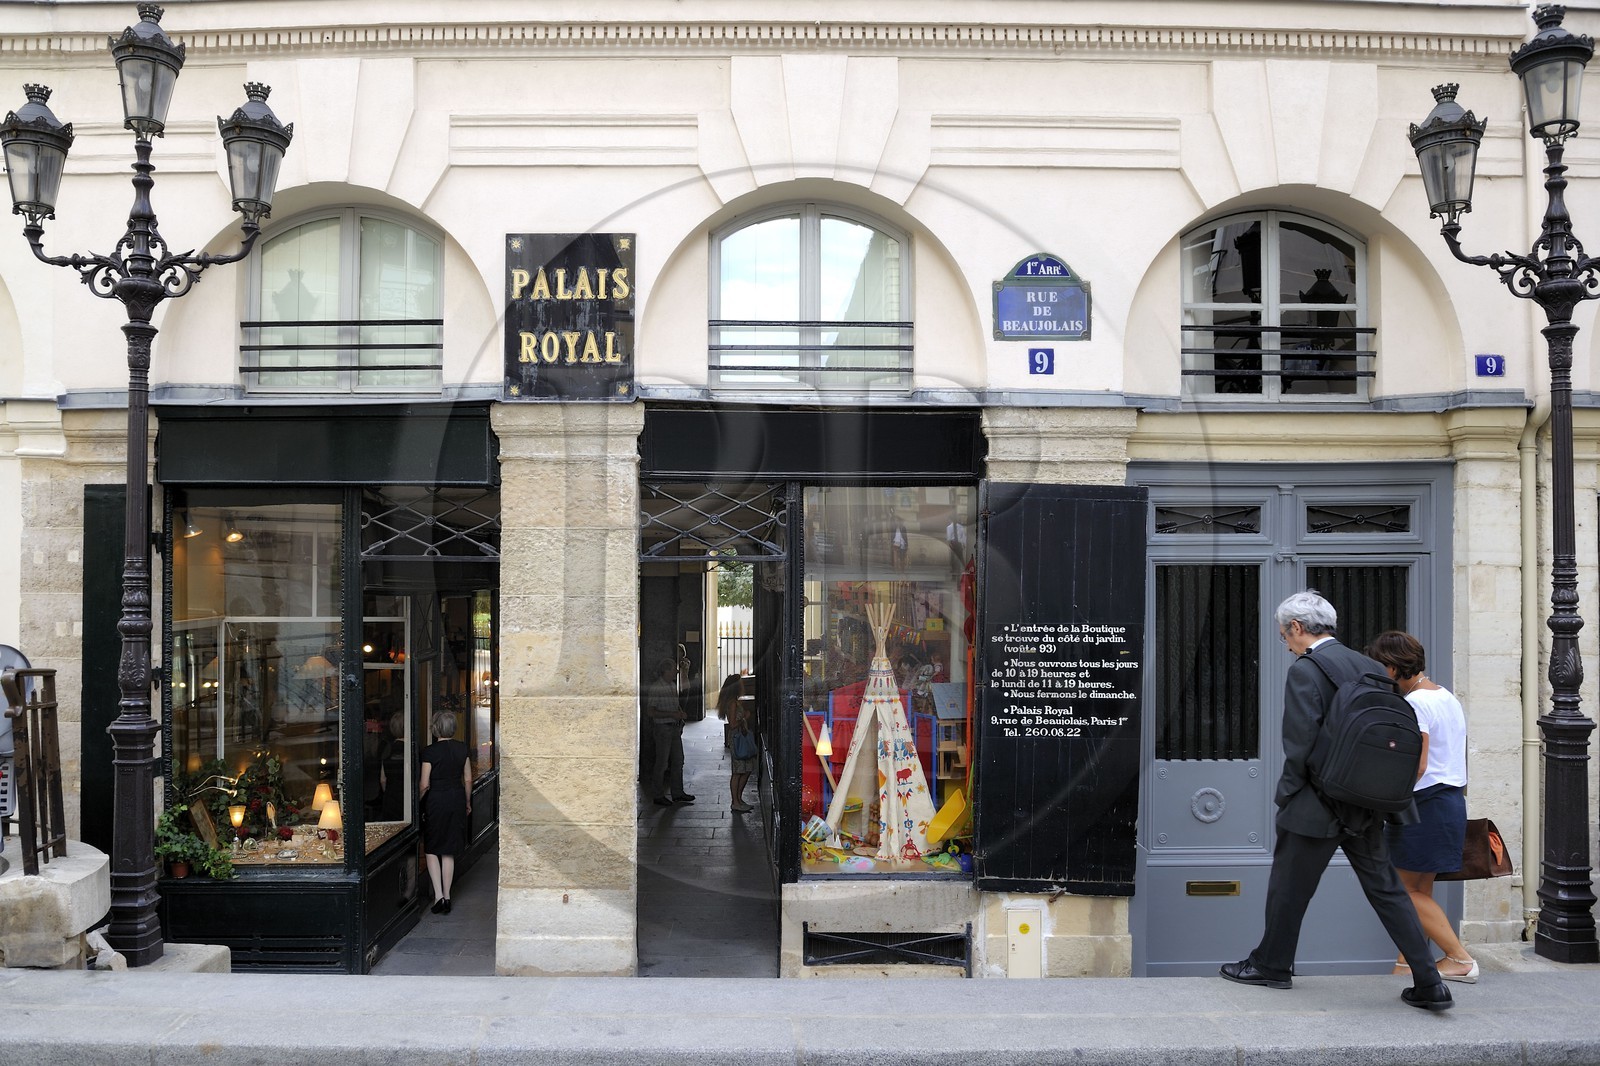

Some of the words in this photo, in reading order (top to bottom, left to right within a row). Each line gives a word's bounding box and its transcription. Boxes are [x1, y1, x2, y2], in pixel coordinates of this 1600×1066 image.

[511, 267, 630, 300] PALAIS
[1026, 291, 1058, 303] RUE
[1033, 306, 1052, 317] DE
[1002, 320, 1083, 332] BEAUJOLAIS
[518, 331, 621, 363] ROYAL
[1034, 351, 1049, 373] 9
[1485, 356, 1497, 374] 9
[1057, 624, 1069, 633] de
[1070, 624, 1080, 633] la
[1081, 624, 1126, 635] Boutique
[1005, 633, 1040, 643] trouve
[1042, 634, 1055, 643] du
[1057, 634, 1080, 643] côté
[1082, 634, 1095, 643] du
[1095, 634, 1126, 646] jardin.
[1039, 643, 1057, 654] 93)
[1010, 658, 1036, 668] Nous
[1079, 659, 1101, 668] tous
[1101, 659, 1116, 668] les
[1115, 659, 1139, 671] jours
[991, 668, 1004, 678] de
[1005, 668, 1017, 678] 10
[1019, 669, 1027, 678] à
[1027, 668, 1039, 678] 19
[1040, 669, 1077, 678] heures
[1078, 669, 1091, 678] et
[990, 680, 1000, 688] le
[1001, 680, 1026, 688] lundi
[1027, 680, 1040, 688] de
[1042, 679, 1052, 688] 11
[1055, 680, 1063, 688] à
[1063, 679, 1076, 689] 19
[1077, 680, 1115, 689] heures.
[1010, 689, 1035, 698] Nous
[1036, 690, 1077, 699] fermons
[1078, 690, 1088, 699] le
[1089, 690, 1137, 700] dimanche.
[1010, 705, 1042, 715] Palais
[1044, 705, 1073, 717] Royal
[1020, 716, 1033, 725] de
[1090, 716, 1118, 726] Paris
[1003, 727, 1021, 737] Tél.
[1025, 727, 1081, 737] 260.08.22
